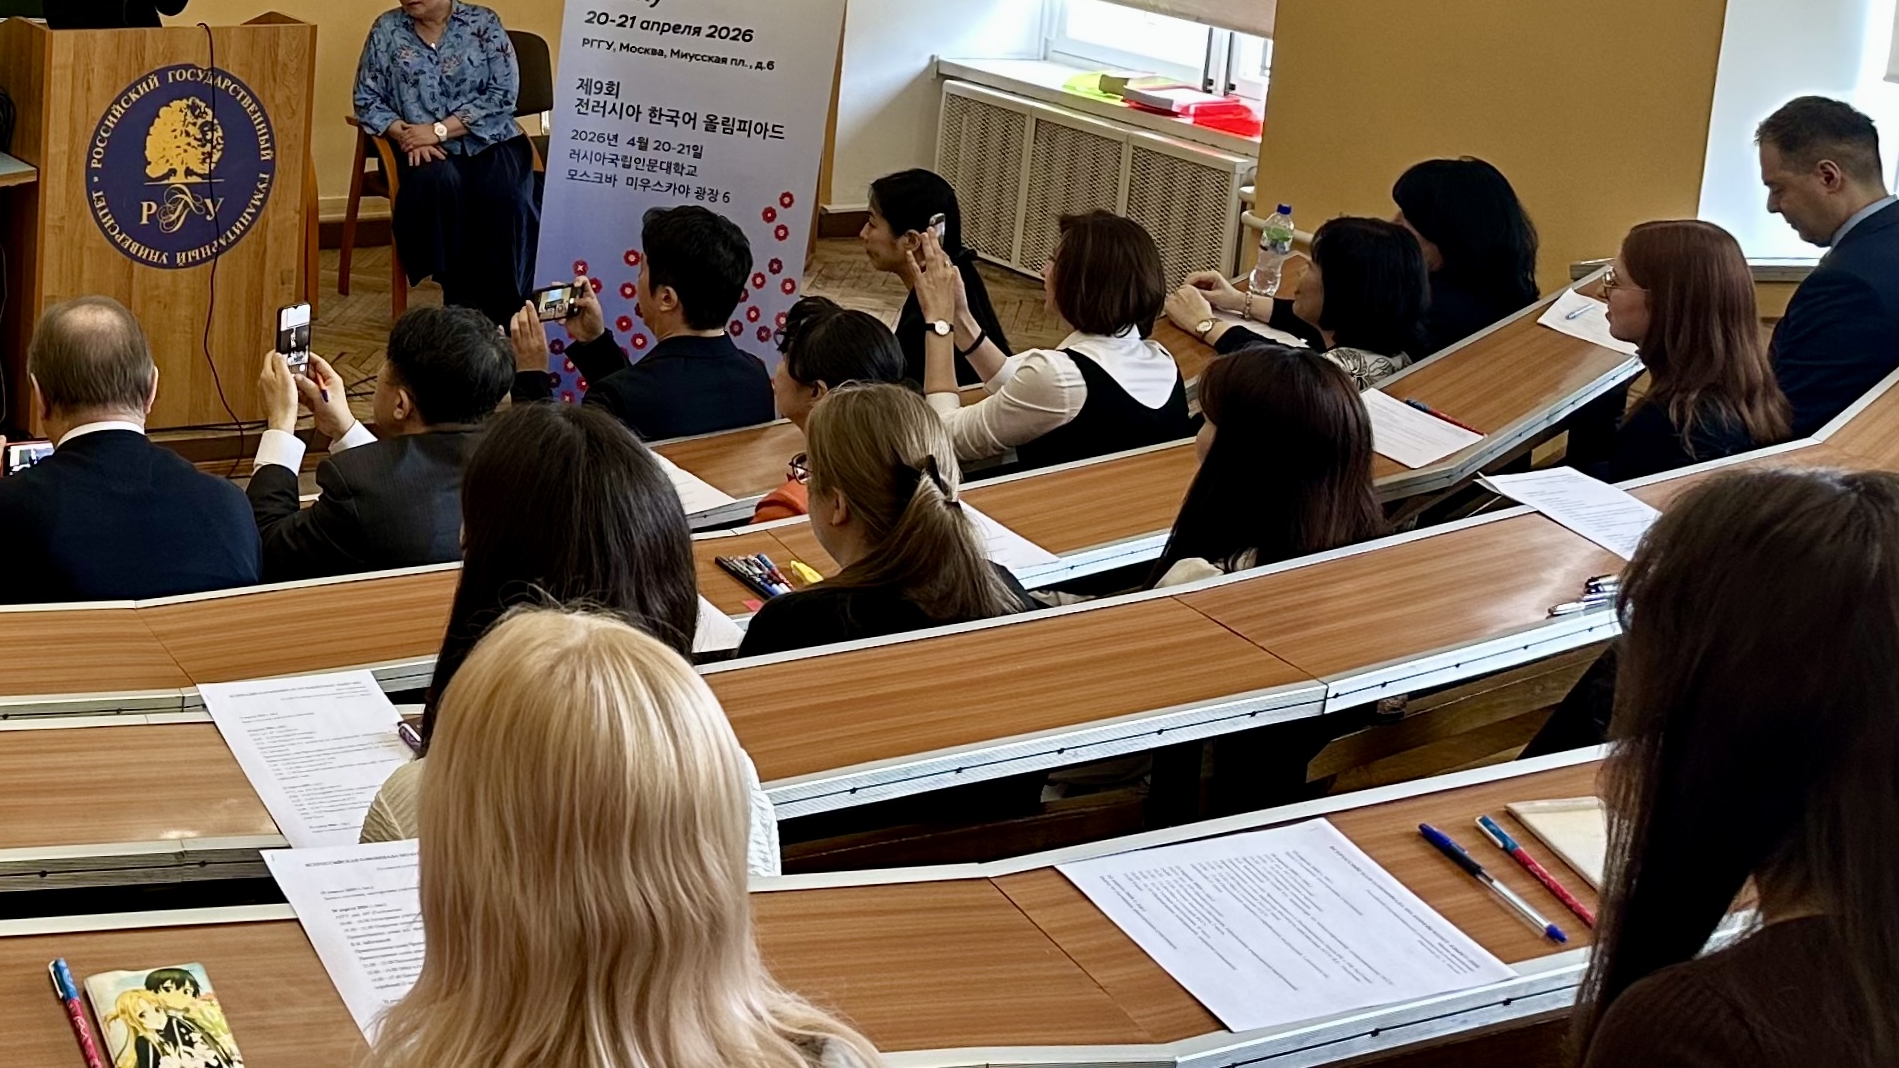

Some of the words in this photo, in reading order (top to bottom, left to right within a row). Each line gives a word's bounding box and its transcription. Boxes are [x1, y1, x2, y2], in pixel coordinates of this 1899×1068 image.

[584, 10, 636, 29] 20-21
[640, 19, 702, 36] апреля
[705, 24, 754, 43] 2026
[582, 37, 616, 52] РГГУ,
[619, 42, 667, 58] Москва,
[670, 48, 727, 65] Миусская
[755, 60, 775, 71] д.6
[576, 77, 620, 99] 제9회
[90, 75, 160, 169] РОССИЙСКИЙ
[167, 68, 274, 161] ГОСУДАРСТВЕННЫЙ
[575, 97, 642, 122] 전러시아
[648, 106, 698, 130] 한국어
[703, 114, 785, 140] 올림피아드
[570, 129, 619, 148] 2026년
[626, 136, 649, 152] 4월
[653, 140, 704, 159] 20-21일
[569, 149, 698, 178] 러시아국립인문대학교
[566, 168, 617, 187] 모스크바
[626, 175, 691, 199] 미우스카야
[694, 186, 720, 203] 광장
[722, 191, 730, 203] 6
[92, 190, 169, 264] УНИВЕРСИТЕТ
[176, 173, 270, 266] ГУМАНИТАРНЫЙ
